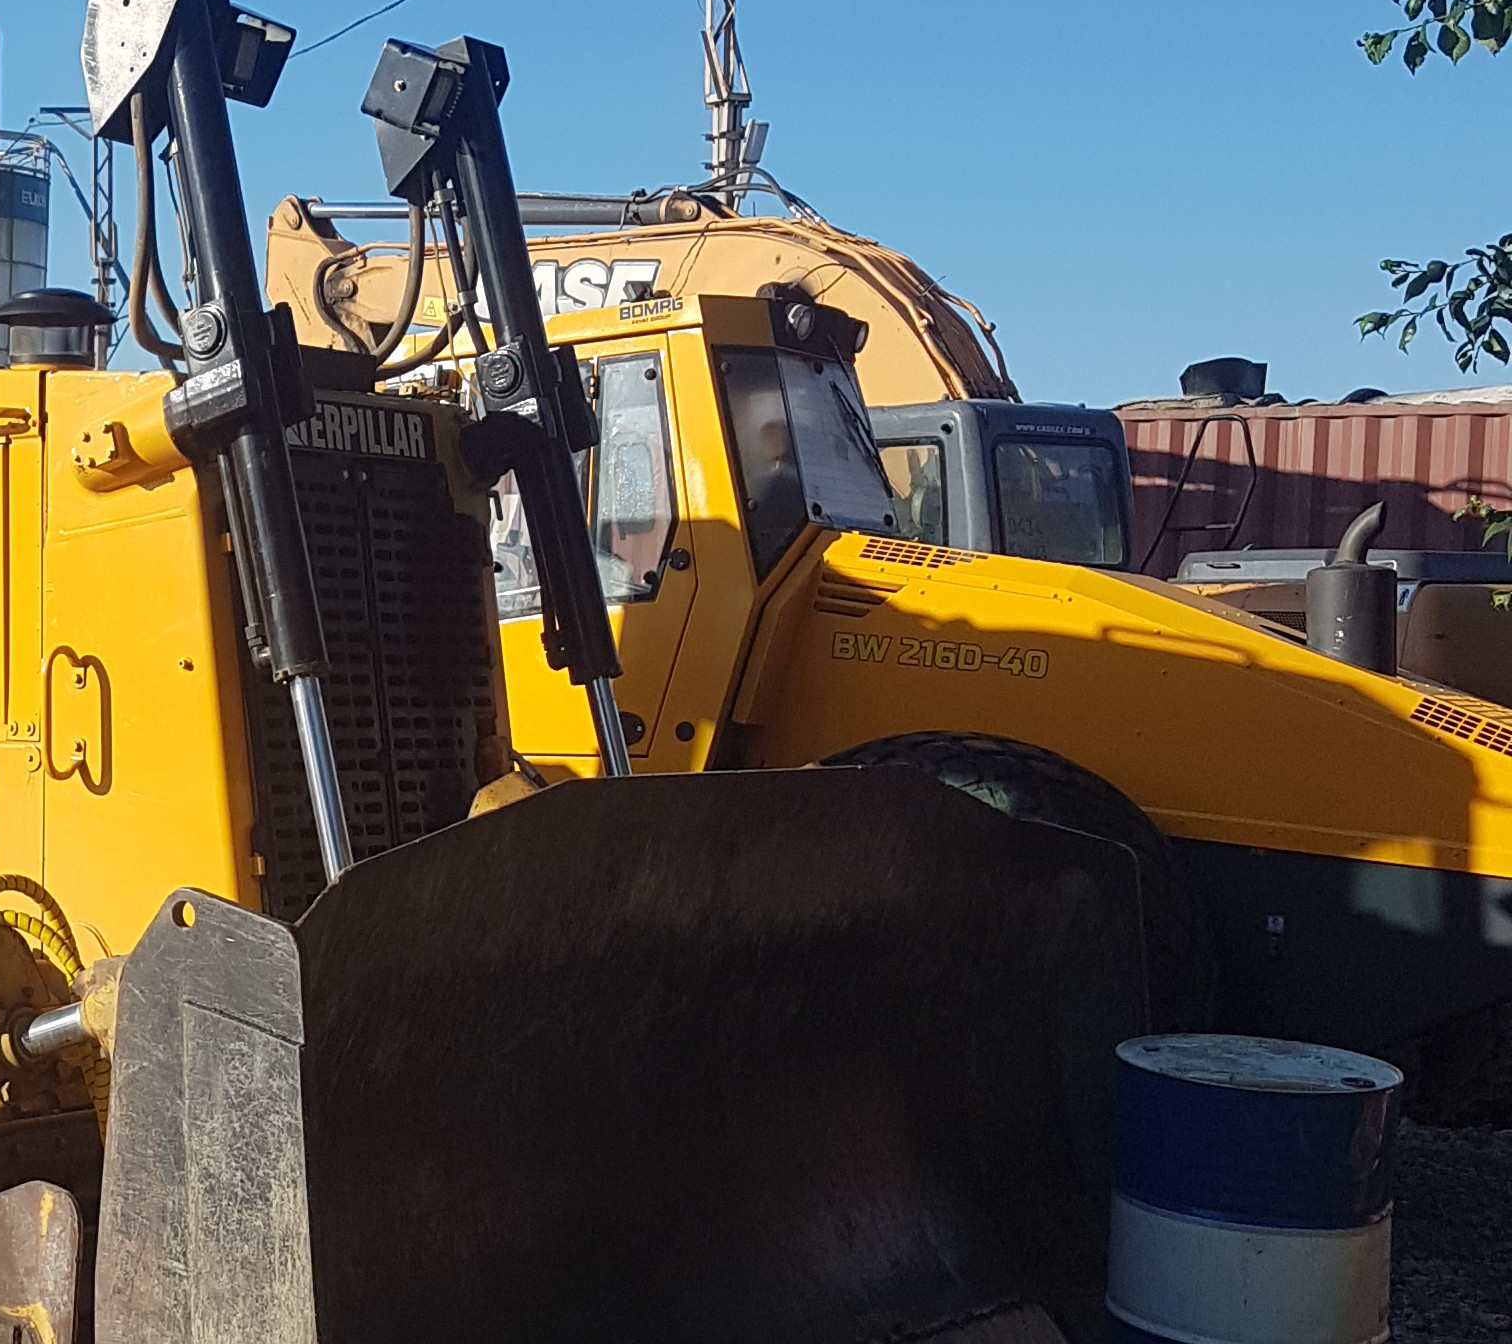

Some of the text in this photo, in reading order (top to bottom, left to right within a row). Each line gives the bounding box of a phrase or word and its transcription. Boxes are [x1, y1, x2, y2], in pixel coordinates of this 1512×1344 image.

[285, 403, 426, 458] ERPILLAR
[832, 631, 1050, 679] BW 216D-40
